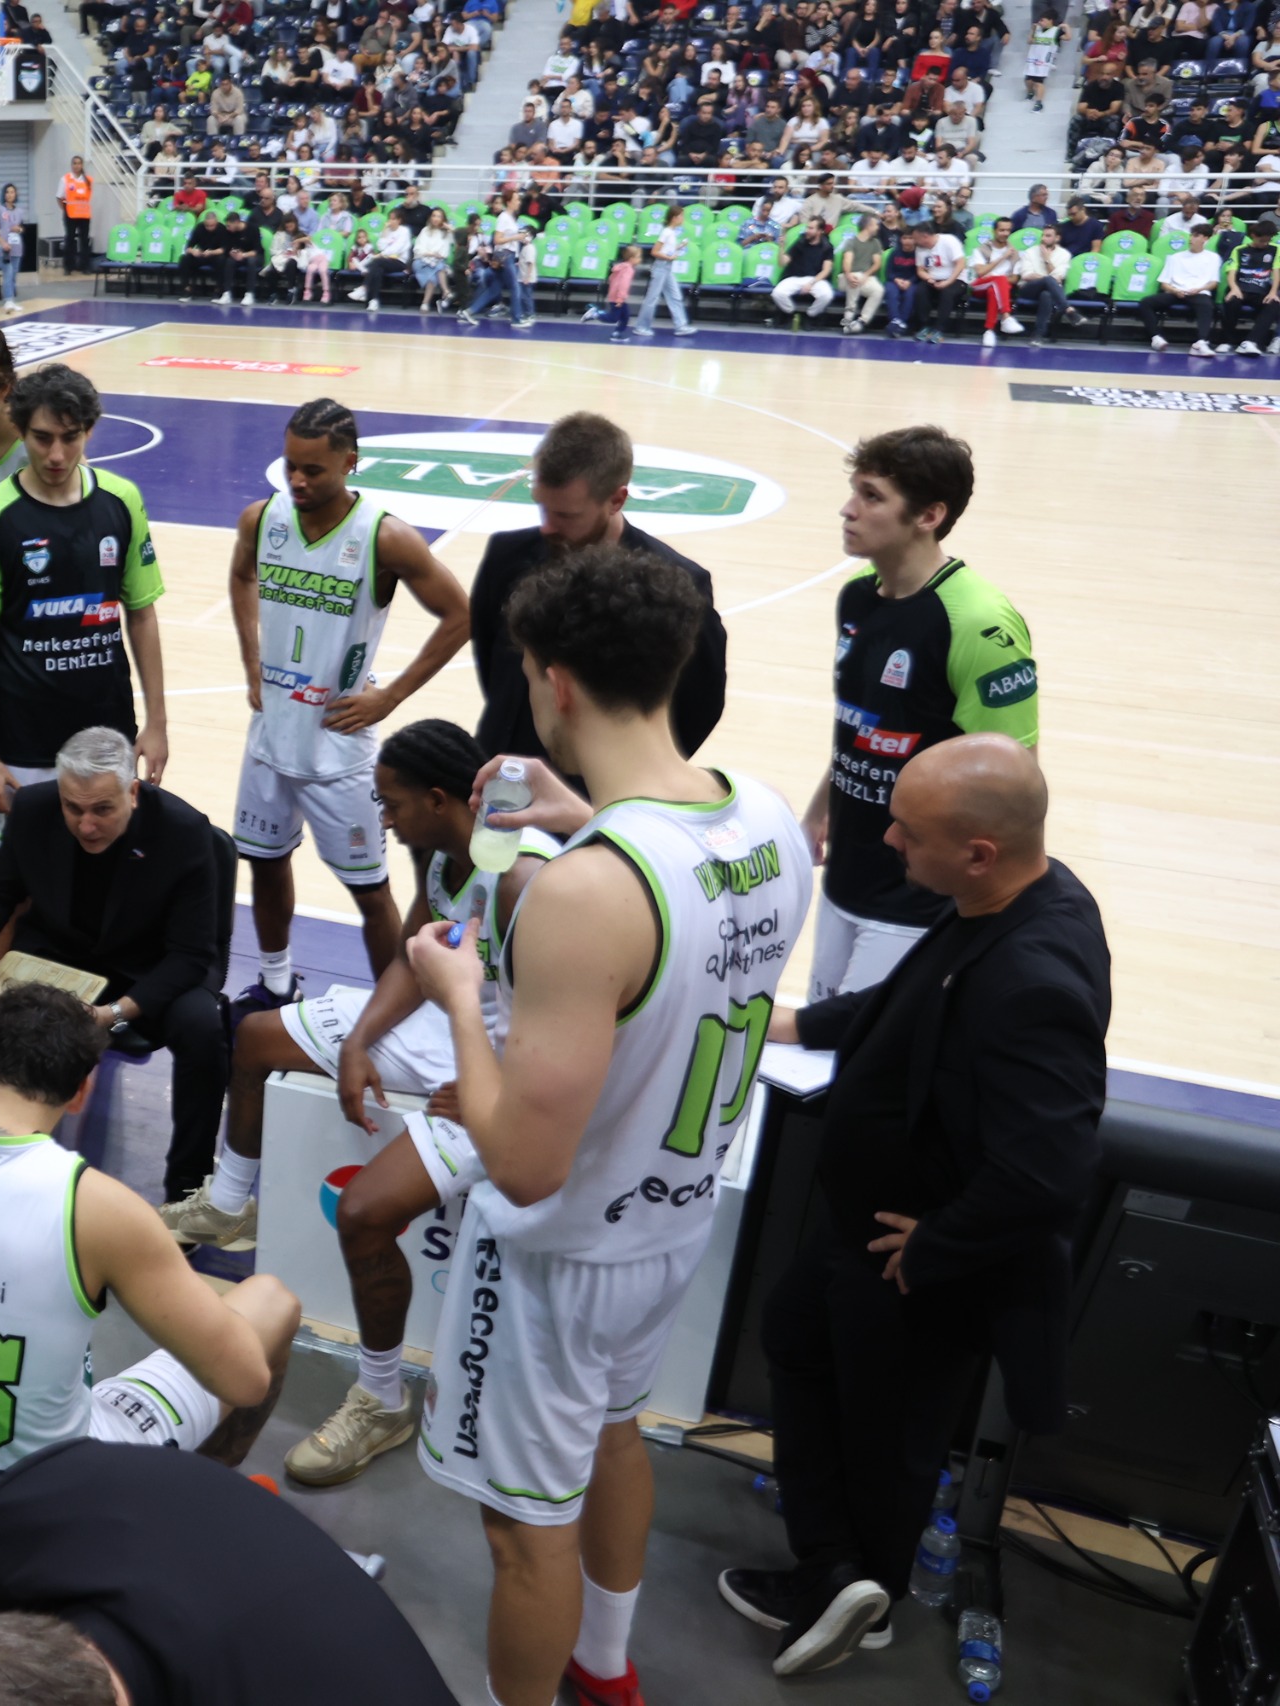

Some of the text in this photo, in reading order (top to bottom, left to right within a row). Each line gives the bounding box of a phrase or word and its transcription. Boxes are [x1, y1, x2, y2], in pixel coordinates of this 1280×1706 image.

[22, 627, 122, 652] Merkezefend
[45, 649, 113, 672] DENİZLİ
[262, 667, 297, 688] UKA
[869, 732, 911, 754] tel
